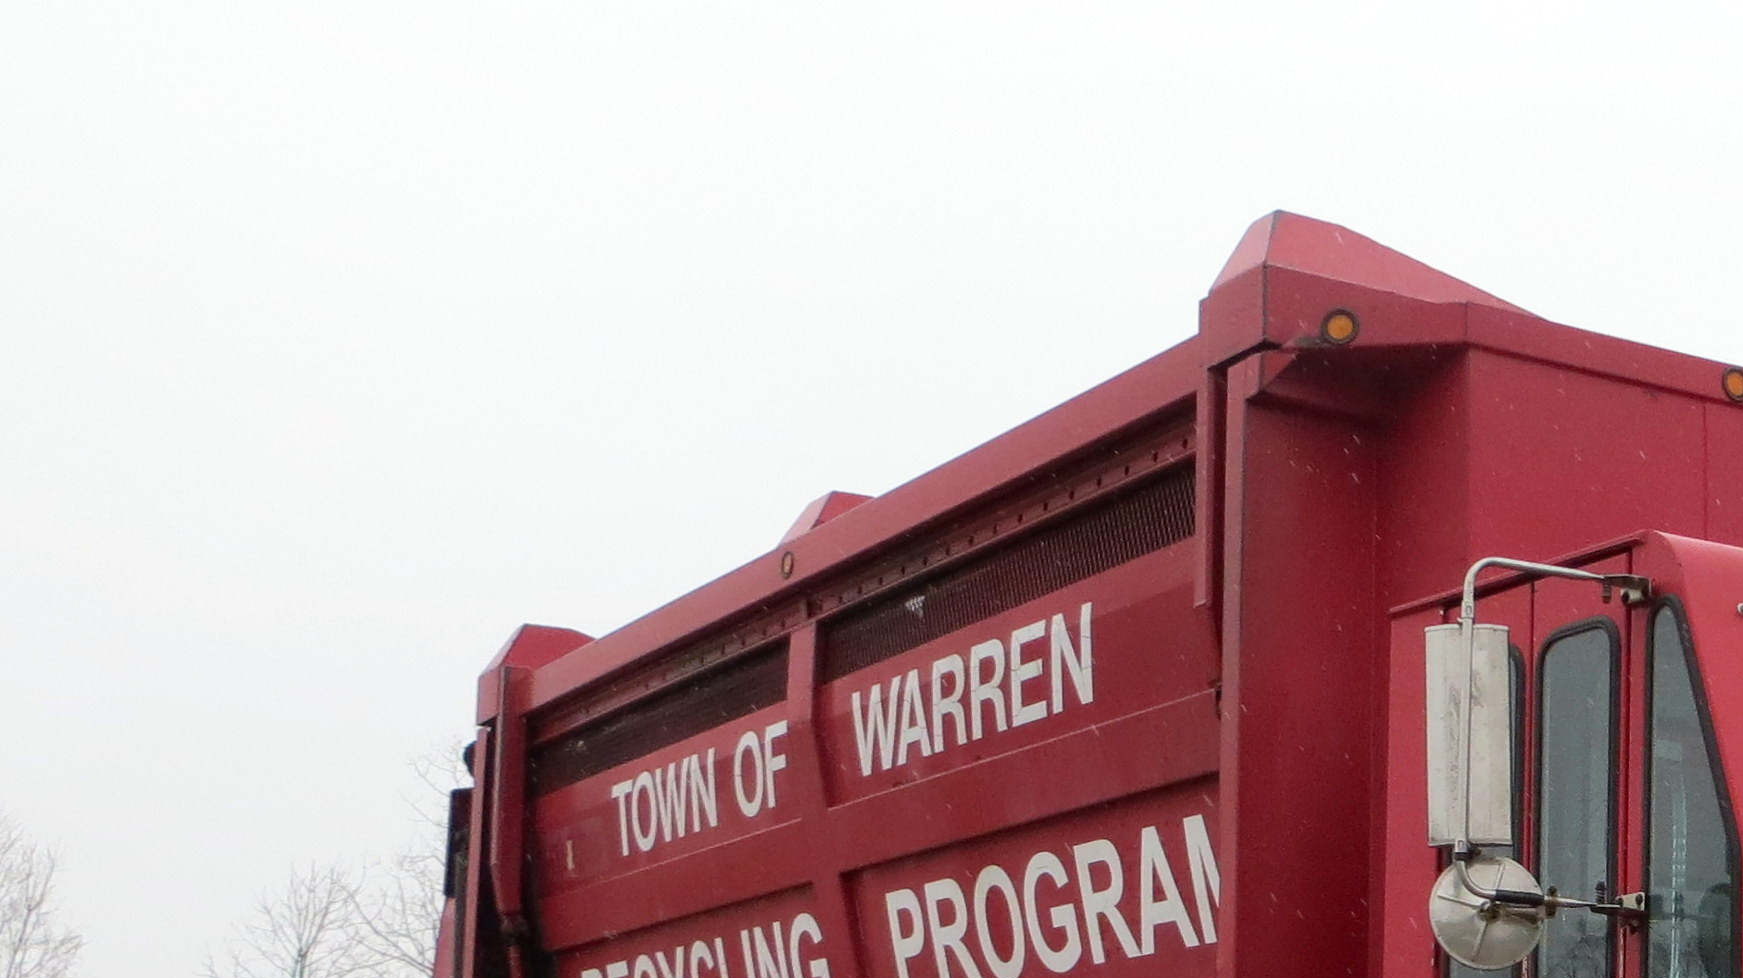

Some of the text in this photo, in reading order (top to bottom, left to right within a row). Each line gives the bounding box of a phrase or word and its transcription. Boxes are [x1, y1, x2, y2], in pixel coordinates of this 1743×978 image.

[611, 602, 1095, 857] TOWN OF WARREN
